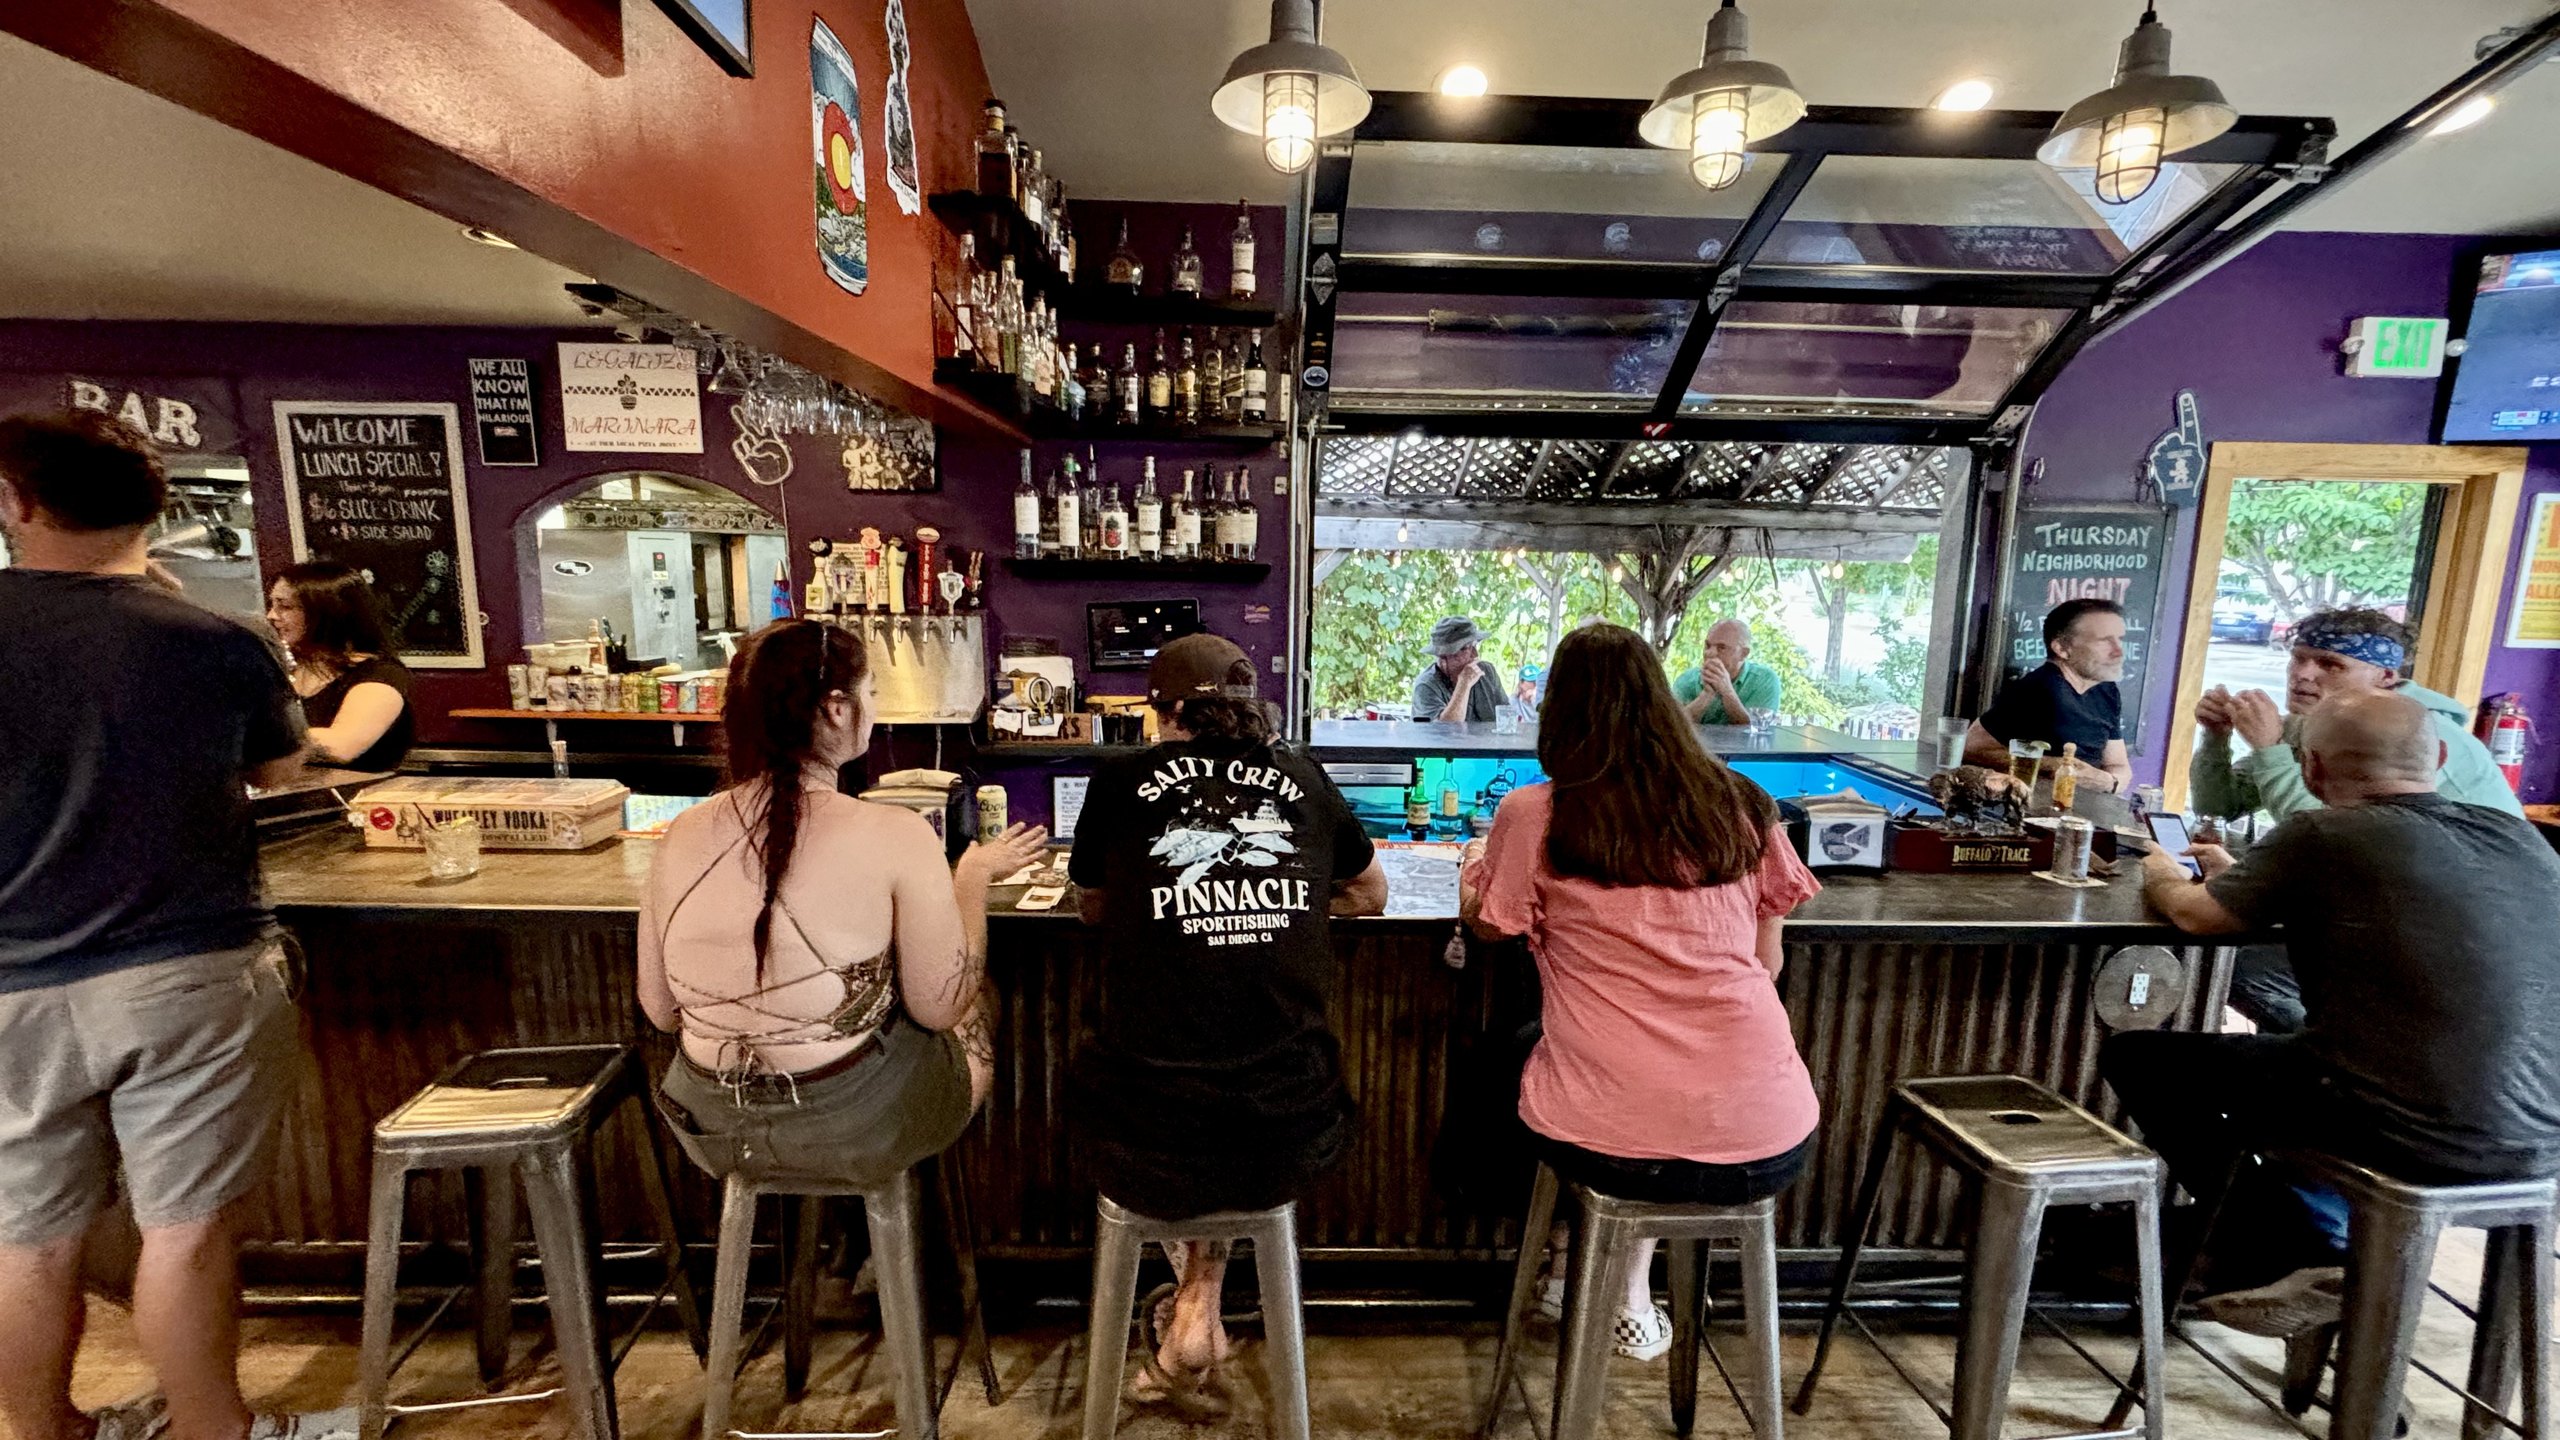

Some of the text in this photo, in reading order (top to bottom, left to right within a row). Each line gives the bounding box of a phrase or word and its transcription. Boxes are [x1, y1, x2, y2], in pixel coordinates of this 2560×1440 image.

[2373, 320, 2436, 369] EXIT
[472, 361, 525, 376] WE ALL
[474, 379, 526, 394] KNOW
[71, 380, 201, 447] BAR
[476, 398, 528, 410] THAT I'M
[479, 413, 530, 423] HILARIOUS
[567, 416, 697, 436] MARINARA
[293, 417, 417, 446] WELCOME
[302, 451, 362, 477] LUNCH
[338, 497, 383, 520] SLICE
[389, 498, 442, 521] DRINK
[360, 525, 388, 540] SIDE
[392, 525, 433, 541] SALAD
[2035, 522, 2152, 547] THURSDAY
[2022, 550, 2148, 571] NEIGHBORHOOD
[2045, 577, 2131, 606] NIGHT
[2013, 638, 2047, 661] BEE
[1137, 756, 1305, 803] SALTY CREW
[503, 810, 547, 830] VODKA
[1952, 844, 2033, 863] BUFFALO TRACE
[1150, 878, 1310, 920] PINNACLE
[1182, 913, 1290, 935] SPORTFISHING
[1207, 936, 1226, 947] SAN
[1261, 932, 1273, 943] CA
